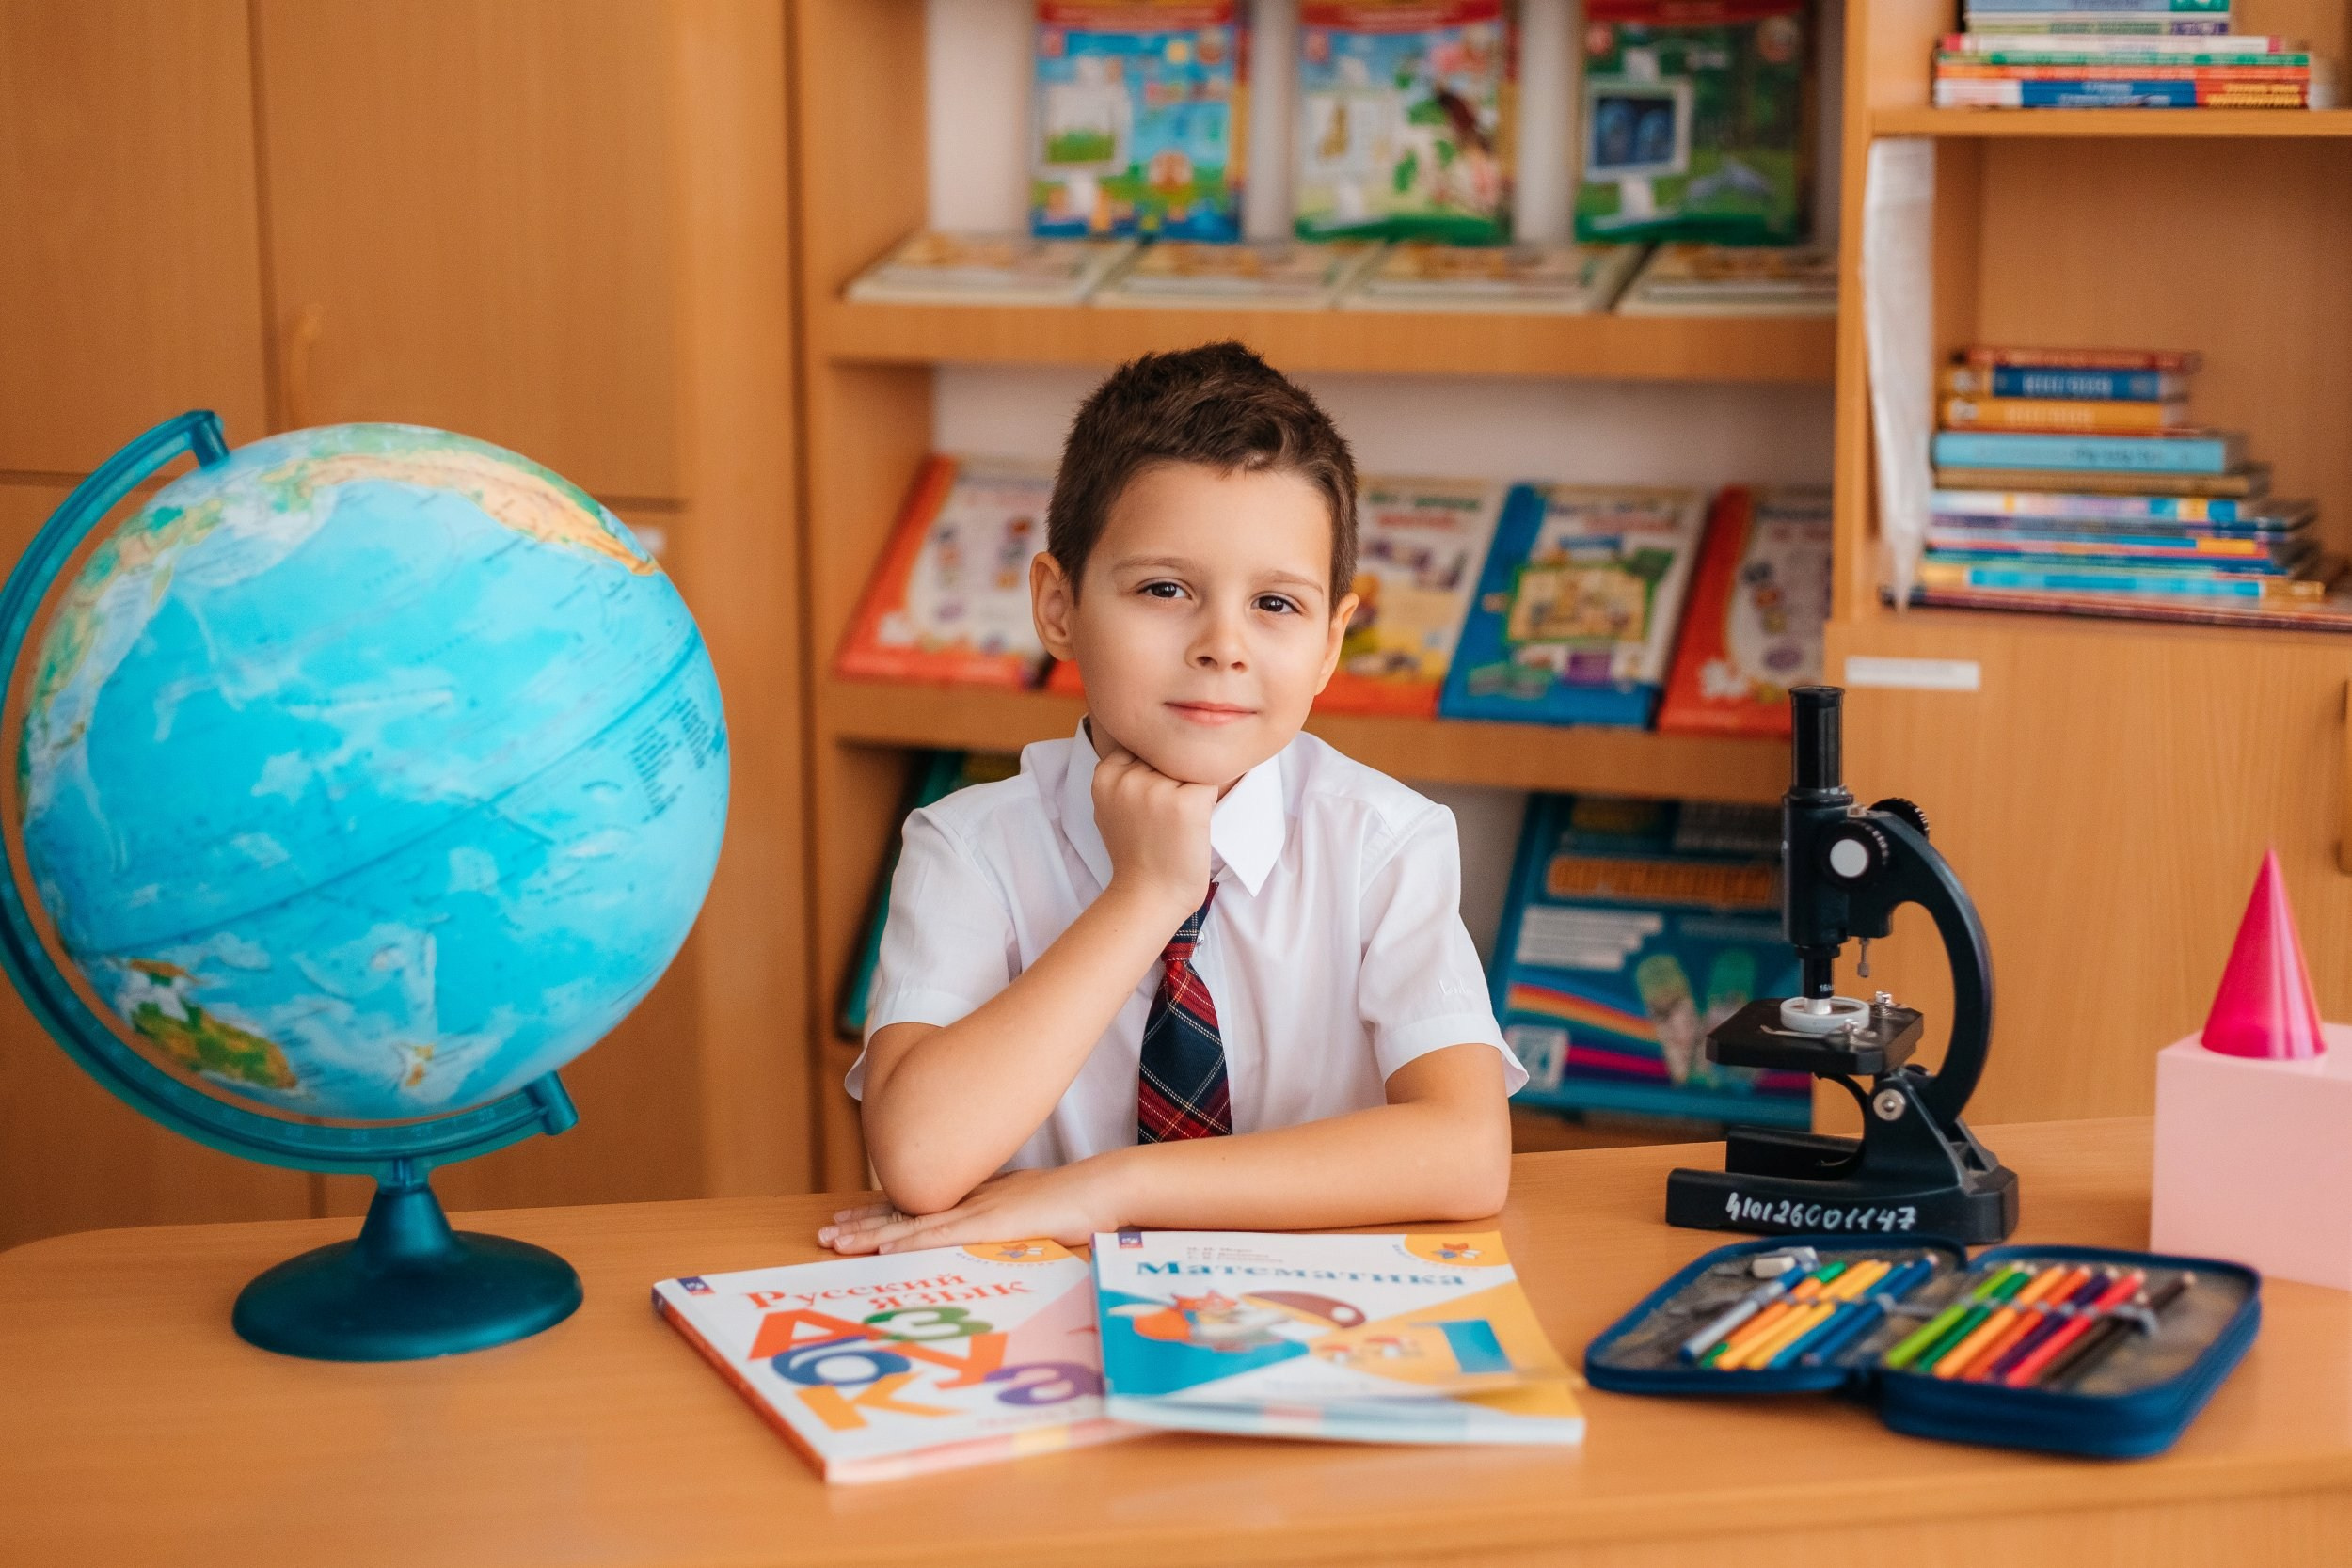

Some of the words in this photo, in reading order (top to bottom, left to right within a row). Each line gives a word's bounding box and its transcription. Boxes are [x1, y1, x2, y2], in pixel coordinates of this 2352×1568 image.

[1725, 1192, 1917, 1231] 410126001147
[1136, 1261, 1464, 1285] Математика
[741, 1274, 968, 1309] Русский
